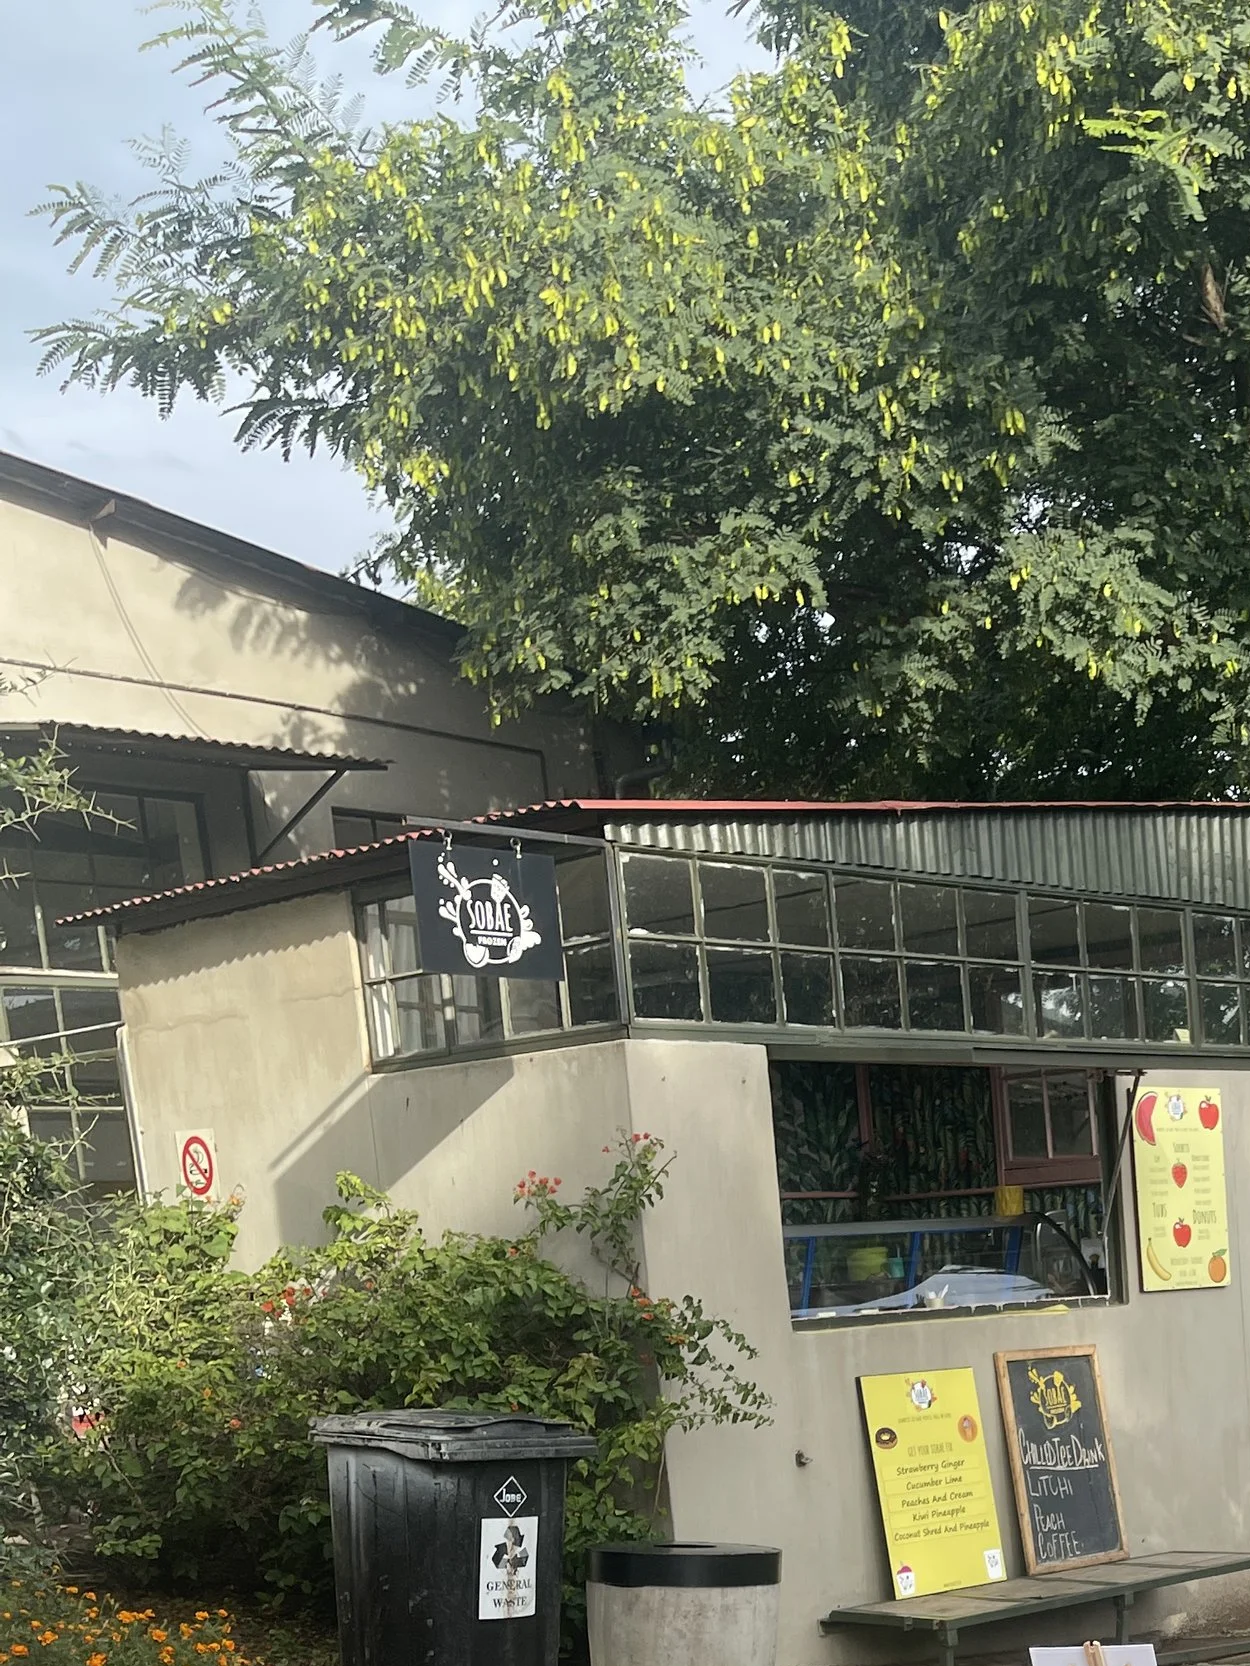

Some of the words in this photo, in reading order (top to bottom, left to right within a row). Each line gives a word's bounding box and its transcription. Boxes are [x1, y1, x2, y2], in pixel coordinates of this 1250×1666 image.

[467, 899, 514, 931] SOBAE
[478, 936, 507, 947] FROZEN
[896, 1462, 939, 1476] Strawberry
[941, 1459, 965, 1471] Ginger
[906, 1478, 942, 1490] Cucumber
[945, 1475, 962, 1485] Lime
[901, 1497, 930, 1508] Peaches
[932, 1493, 947, 1503] And
[949, 1491, 973, 1501] Cream
[912, 1511, 929, 1522] Kiwi
[931, 1505, 966, 1519] Pineapple
[1033, 1503, 1066, 1532] PEACH
[894, 1530, 921, 1541] Coconut
[923, 1526, 941, 1537] Shred
[944, 1523, 957, 1533] And
[960, 1519, 990, 1531] Pineapple
[486, 1579, 532, 1592] GENERAL
[493, 1596, 527, 1608] WASTE
